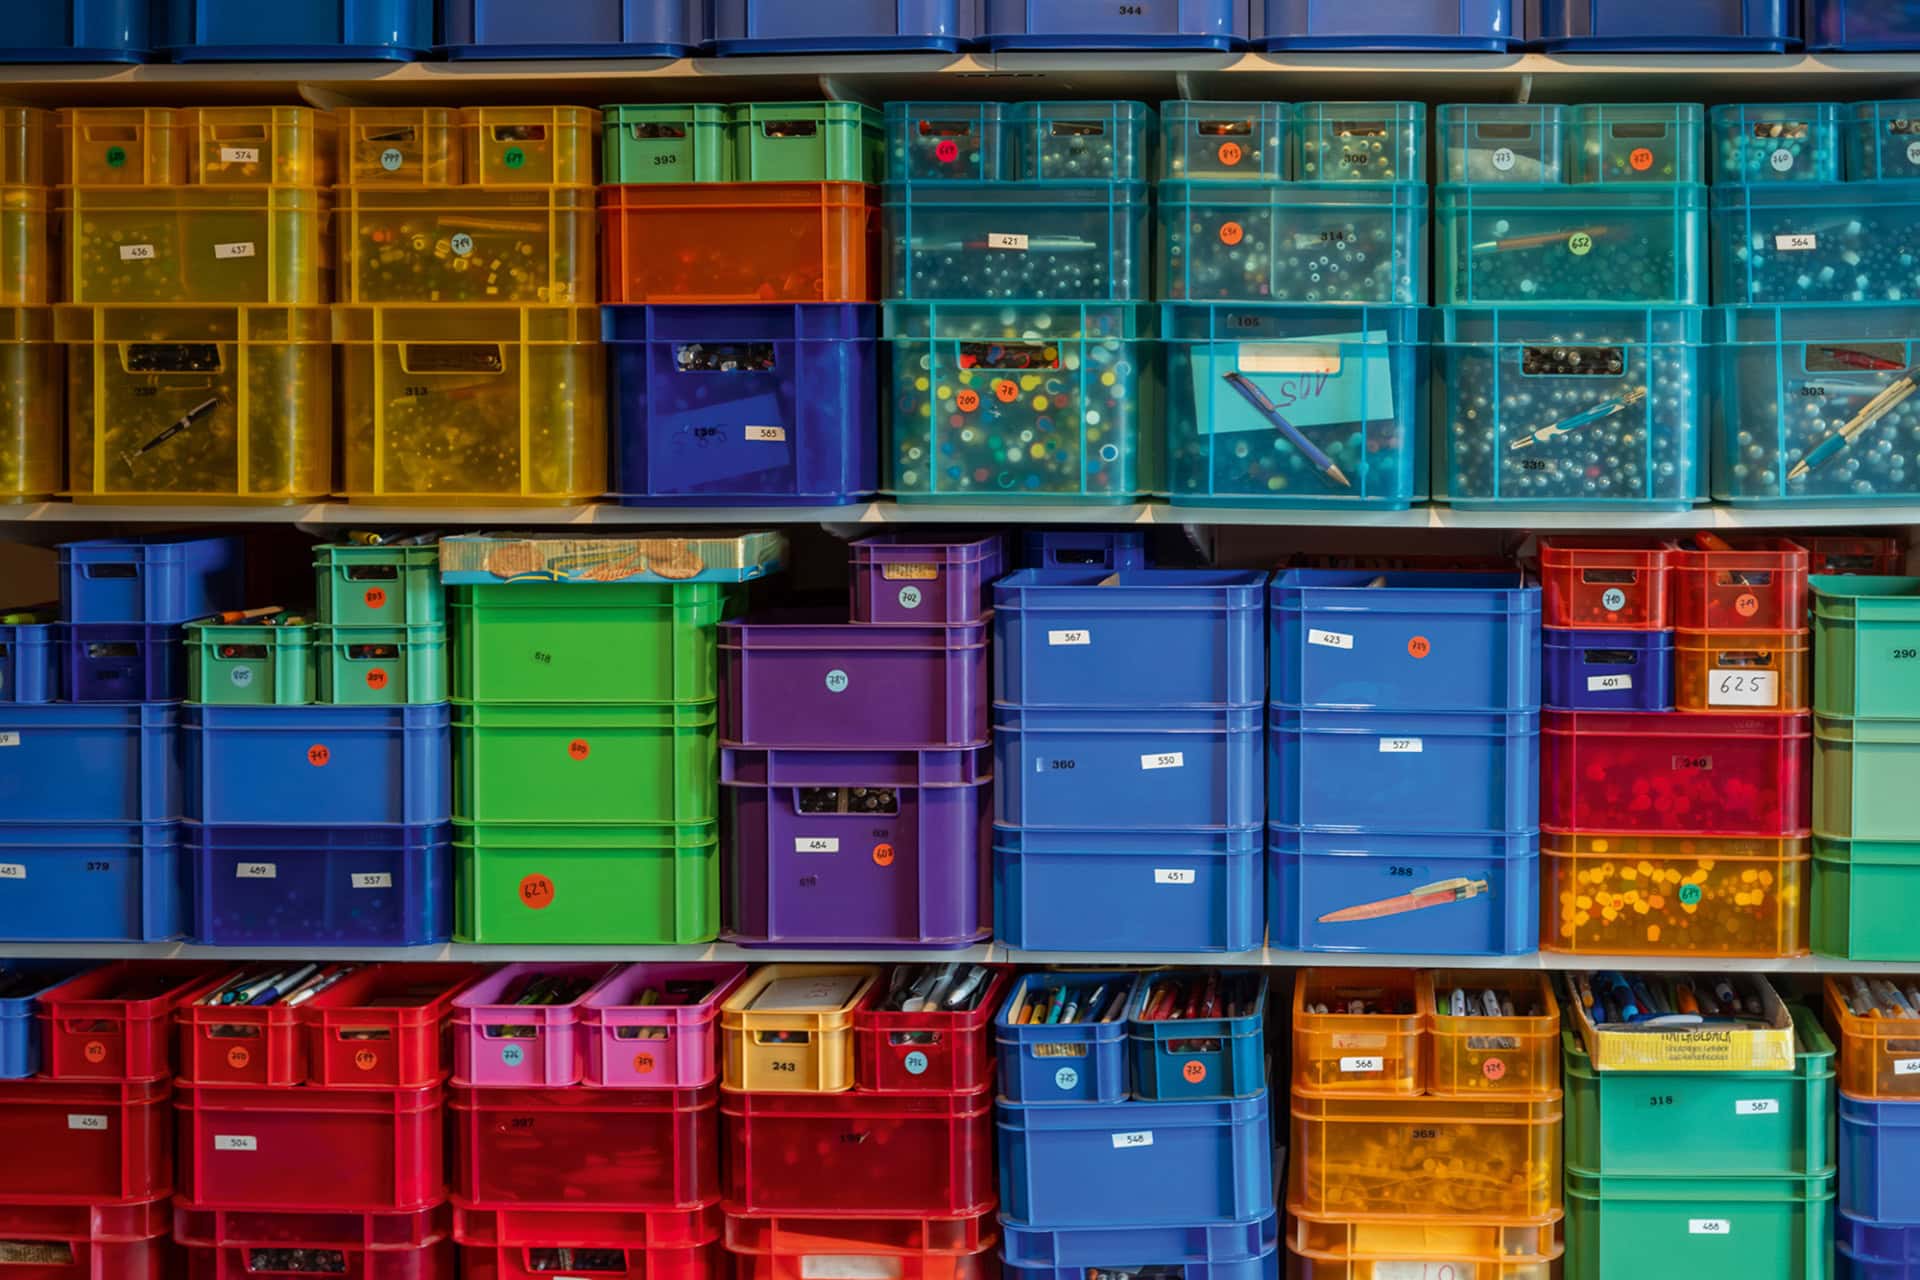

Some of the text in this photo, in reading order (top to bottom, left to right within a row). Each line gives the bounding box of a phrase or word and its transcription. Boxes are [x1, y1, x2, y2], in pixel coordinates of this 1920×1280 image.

[1119, 6, 1142, 15] 344
[235, 151, 252, 160] 574
[653, 155, 677, 165] 393
[1002, 236, 1018, 246] 421
[1320, 231, 1343, 241] 314
[1800, 386, 1825, 396] 303
[902, 591, 918, 602] 702
[1065, 632, 1082, 642] 567
[1893, 649, 1917, 659] 290
[1602, 677, 1619, 688] 401
[1720, 675, 1767, 694] 625
[1392, 740, 1410, 750] 527
[1167, 871, 1184, 881] 451
[524, 879, 549, 898] 629
[772, 1061, 796, 1072] 243
[1650, 1095, 1673, 1106] 318
